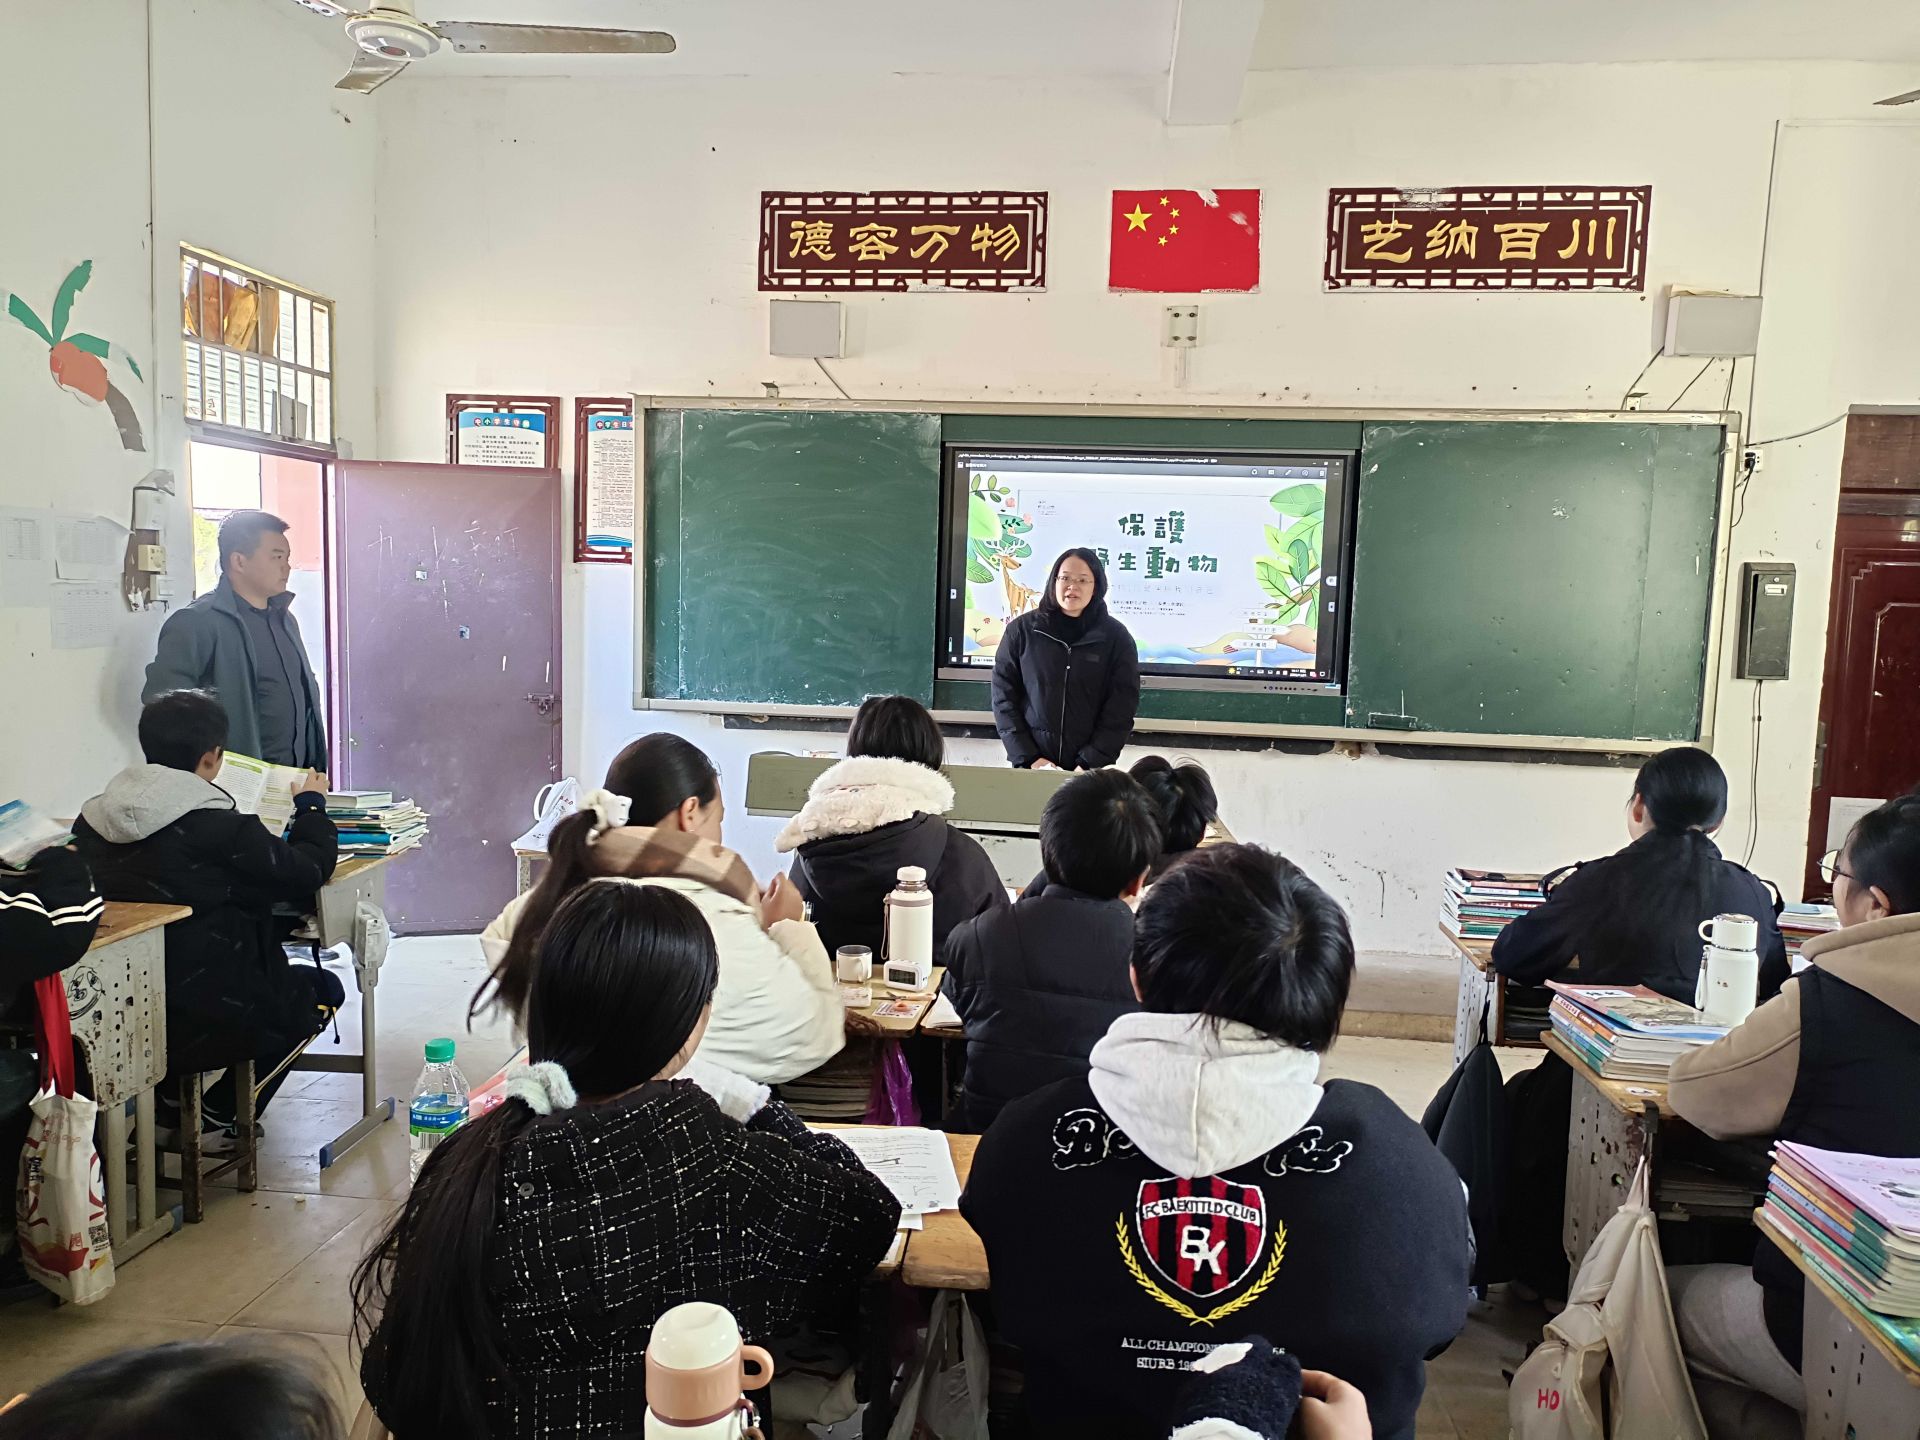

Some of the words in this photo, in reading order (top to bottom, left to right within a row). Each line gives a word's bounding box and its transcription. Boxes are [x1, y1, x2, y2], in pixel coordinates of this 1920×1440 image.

[789, 220, 1021, 263] 德容万物
[1360, 216, 1617, 263] 艺纳百川
[1117, 510, 1186, 544] 保護
[1224, 1204, 1257, 1221] CLUB
[1121, 1337, 1147, 1349] ALL
